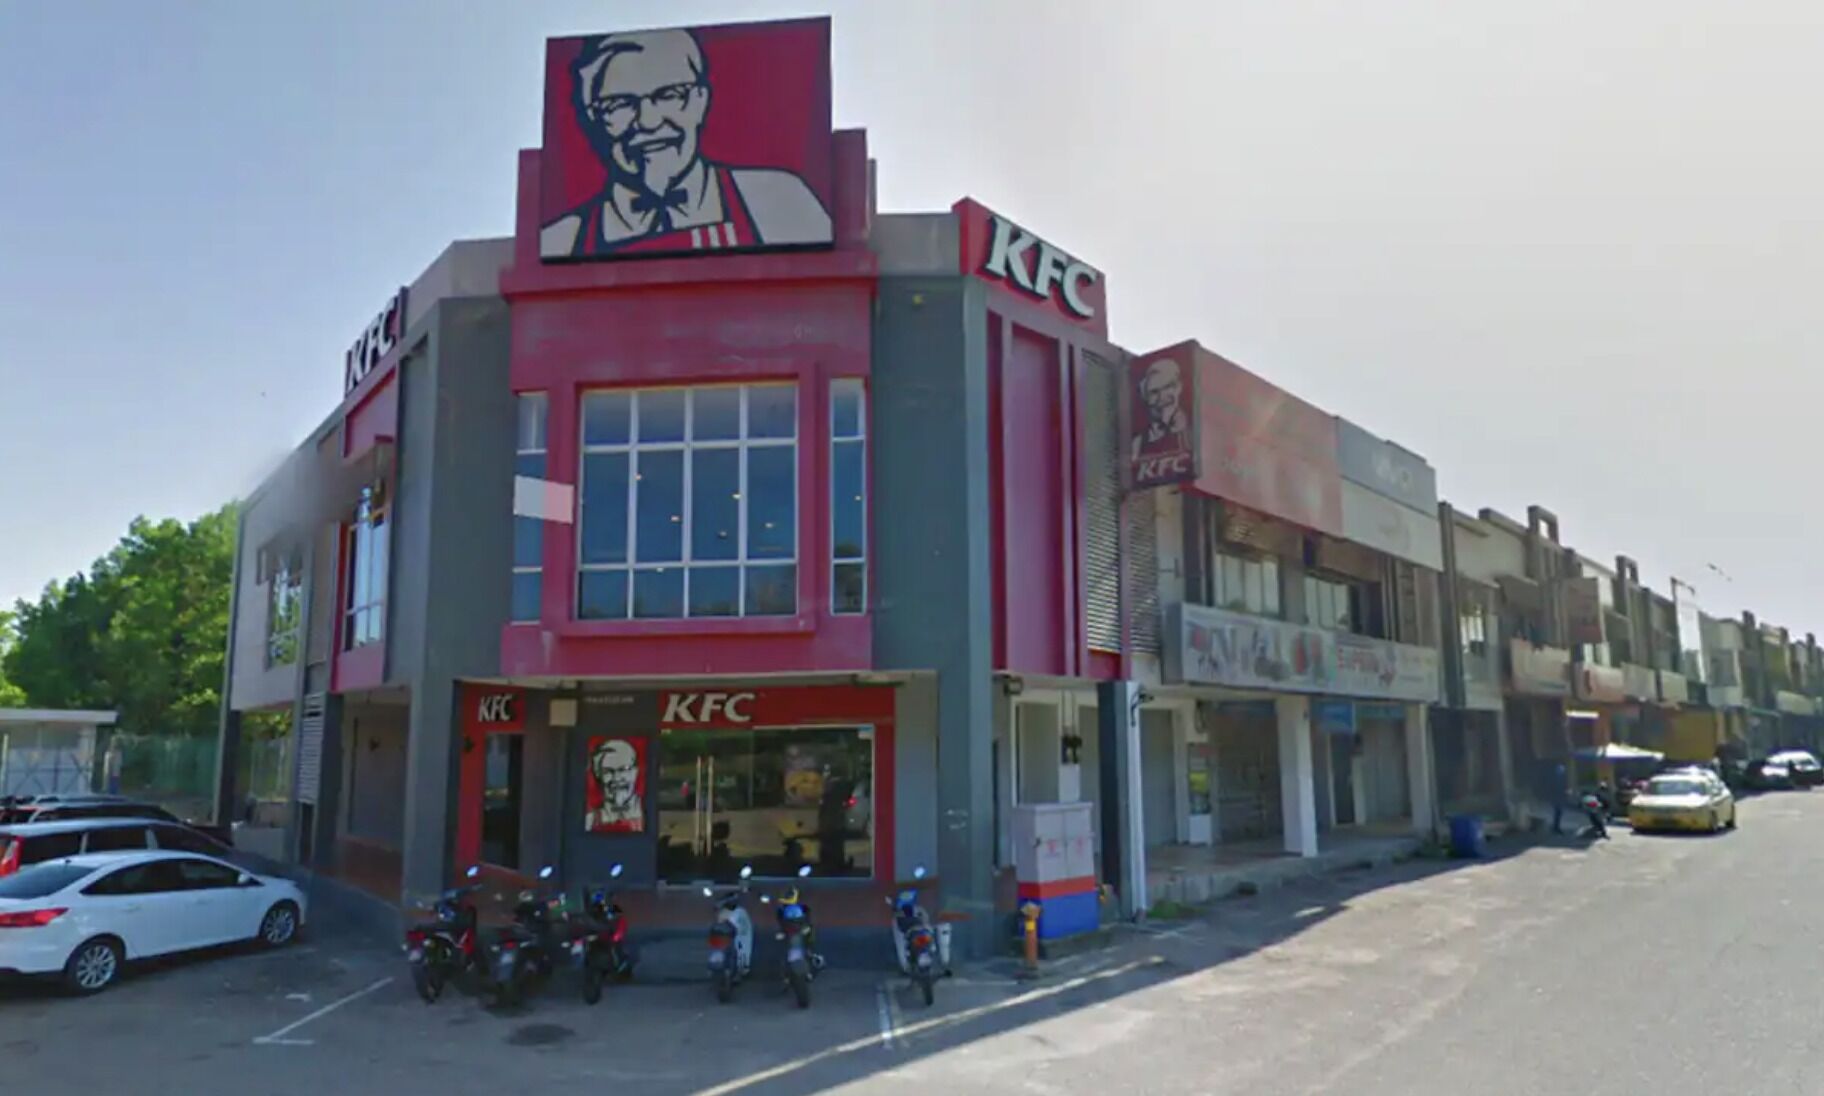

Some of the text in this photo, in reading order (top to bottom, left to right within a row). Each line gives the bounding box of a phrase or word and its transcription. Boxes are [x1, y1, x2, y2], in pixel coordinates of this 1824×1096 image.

[984, 215, 1097, 318] KFC
[345, 296, 398, 392] KFC
[1137, 453, 1190, 481] KFC
[478, 694, 512, 722] KFC
[662, 692, 755, 723] KFC
